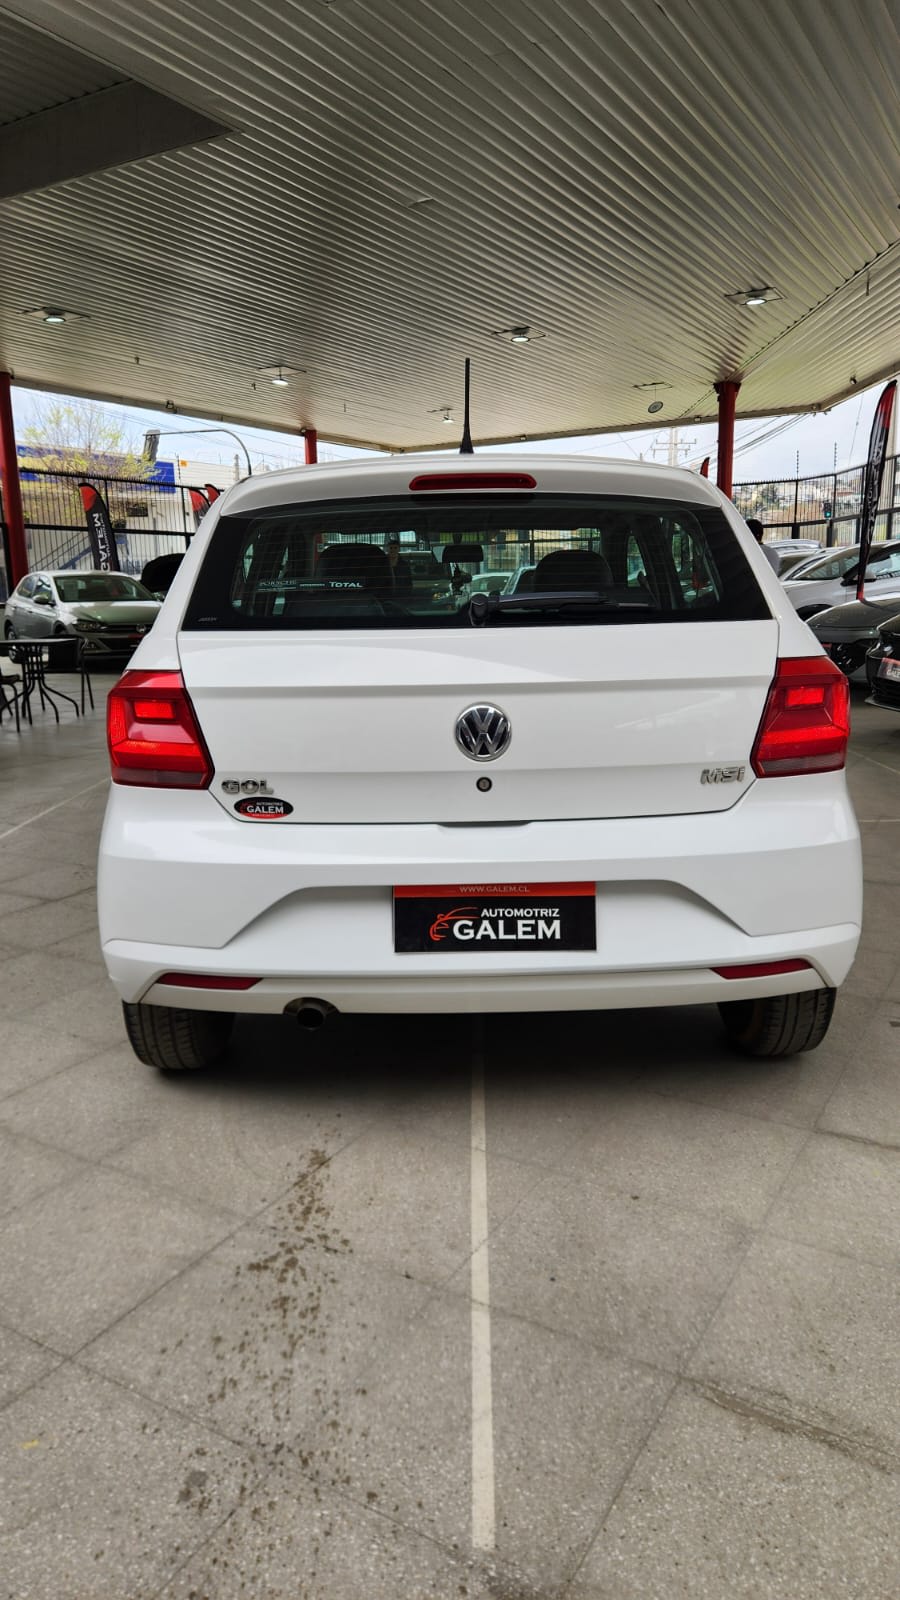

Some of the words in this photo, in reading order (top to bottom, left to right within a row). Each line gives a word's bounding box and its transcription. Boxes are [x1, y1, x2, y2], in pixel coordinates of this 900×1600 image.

[457, 705, 509, 758] VW
[221, 779, 274, 795] GOL
[246, 805, 284, 814] GALEM
[459, 885, 530, 893] WWW.GALEM.CL
[480, 908, 560, 918] AUTOMOTRIZ
[452, 919, 561, 941] GALEM
